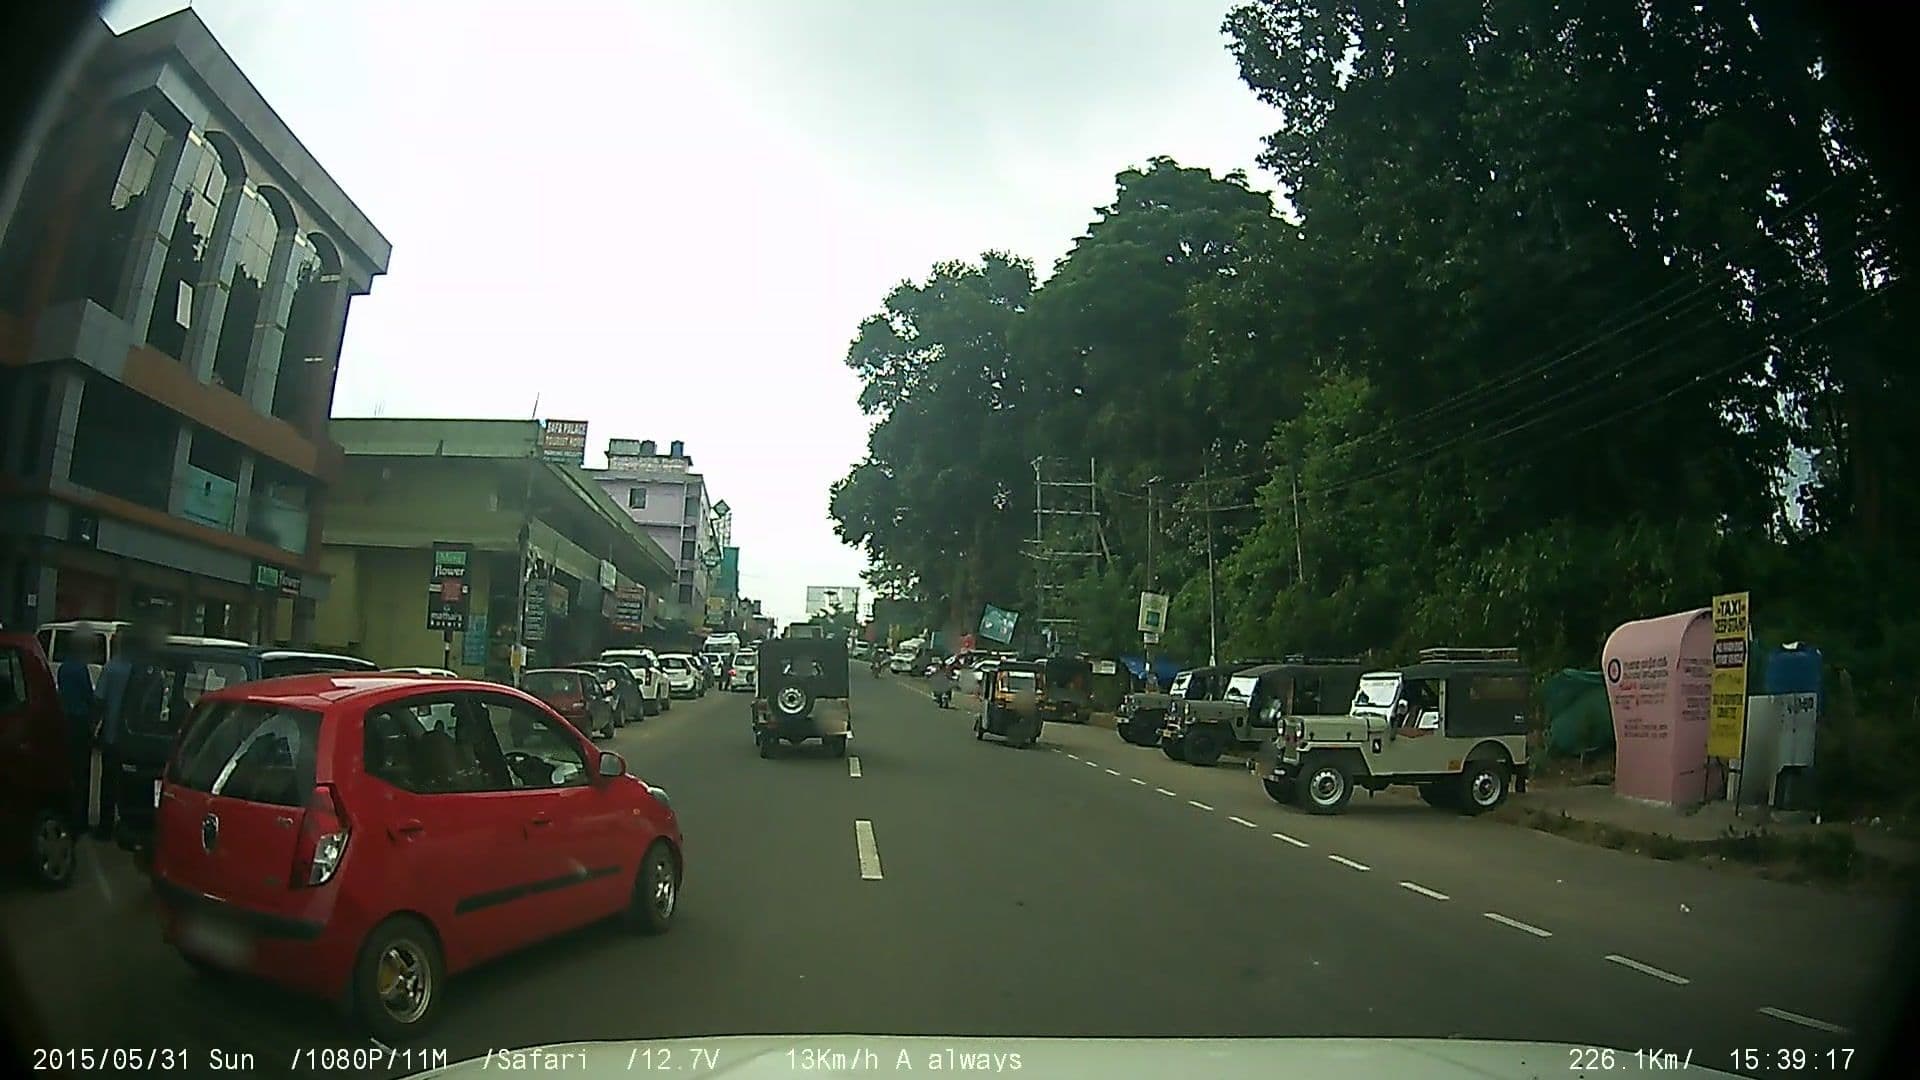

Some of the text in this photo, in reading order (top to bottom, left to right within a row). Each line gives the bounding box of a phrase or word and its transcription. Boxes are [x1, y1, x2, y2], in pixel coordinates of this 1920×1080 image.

[564, 423, 586, 435] PALACE
[434, 564, 465, 577] flower
[1720, 599, 1741, 616] TAXI
